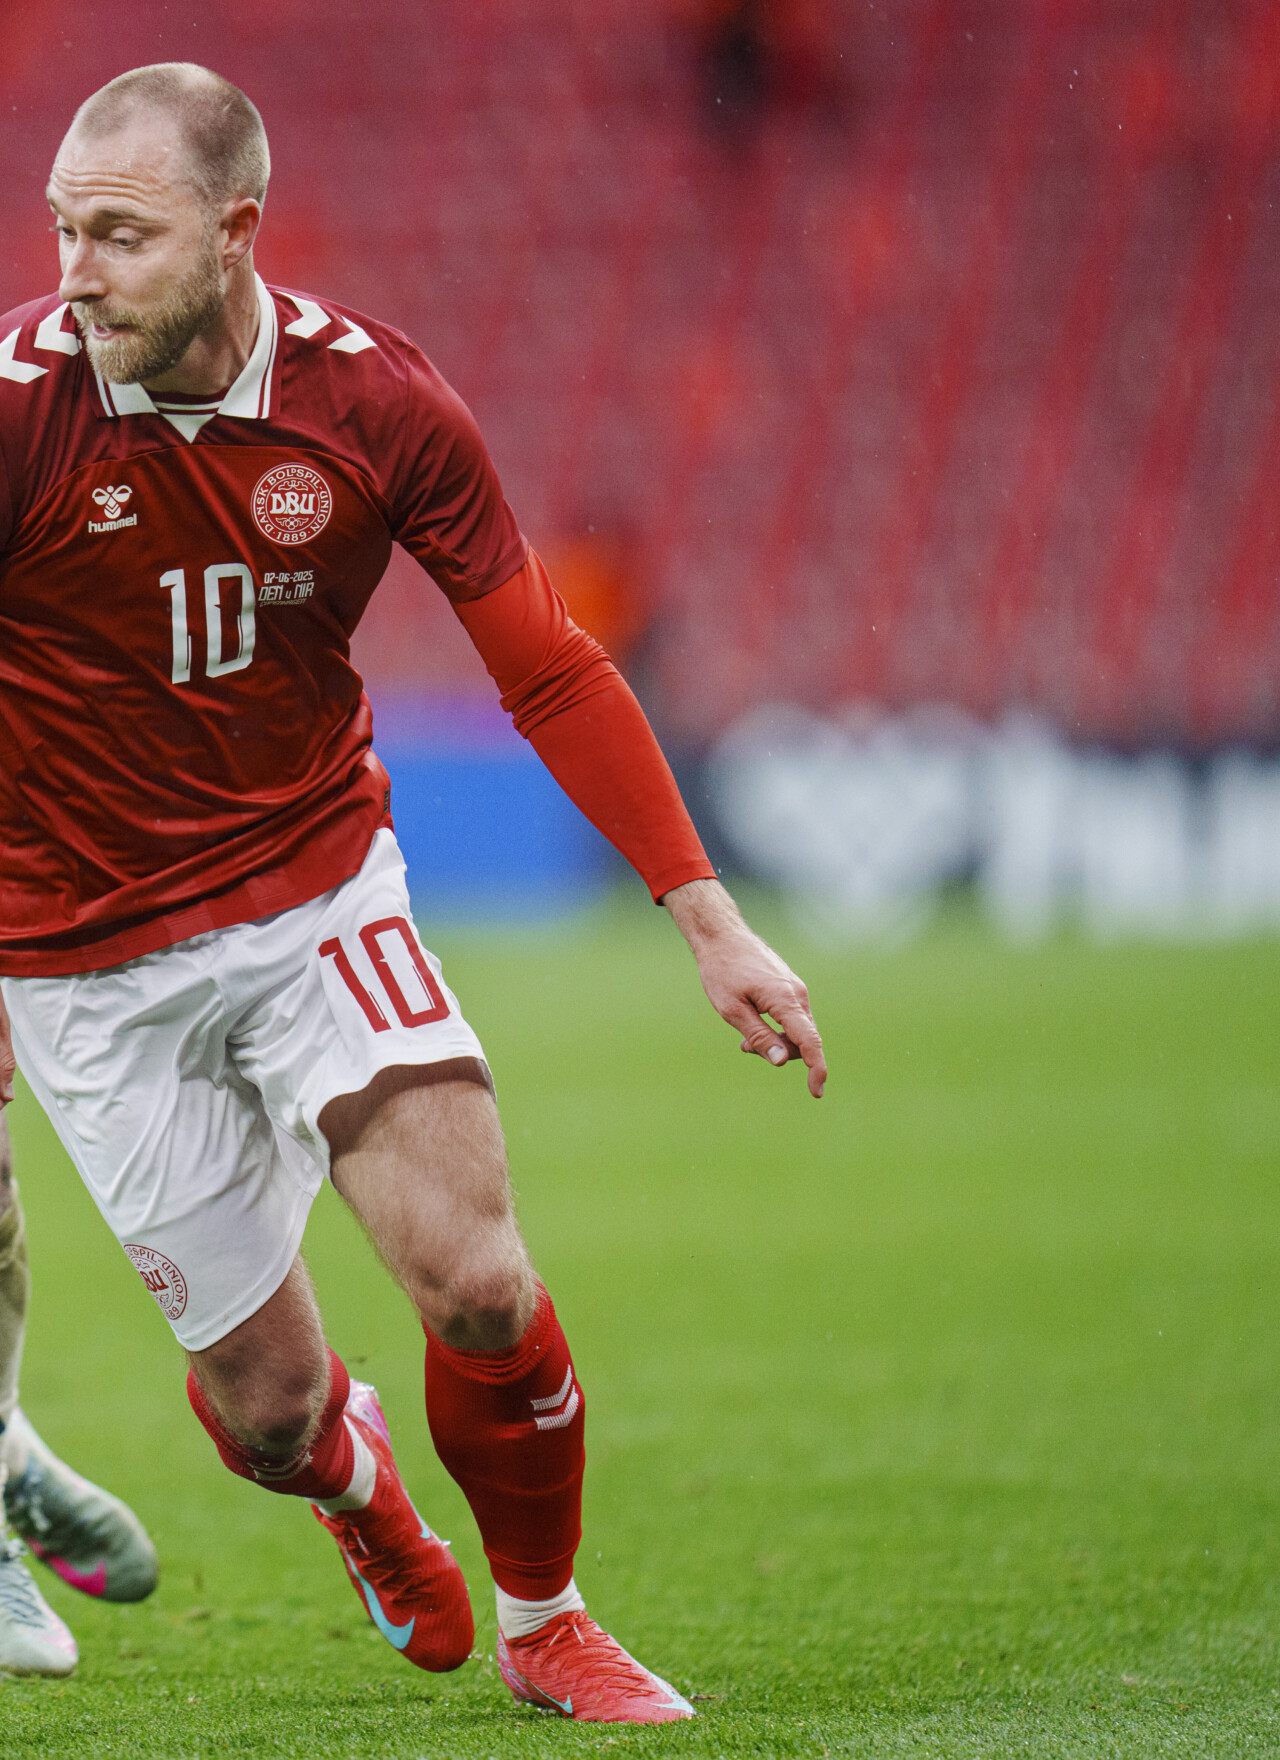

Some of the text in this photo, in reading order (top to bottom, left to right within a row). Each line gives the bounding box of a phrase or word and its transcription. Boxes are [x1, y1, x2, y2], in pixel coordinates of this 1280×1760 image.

[257, 487, 274, 533] DANSK
[269, 491, 316, 515] DBU
[88, 513, 137, 533] hummel
[276, 531, 307, 542] 1889
[264, 570, 314, 584] 07-06-2025
[258, 585, 284, 601] DEN
[294, 582, 315, 598] NIR
[160, 562, 256, 684] 10
[318, 916, 451, 1033] 10
[139, 1269, 169, 1293] BU
[164, 1306, 179, 1319] 89
